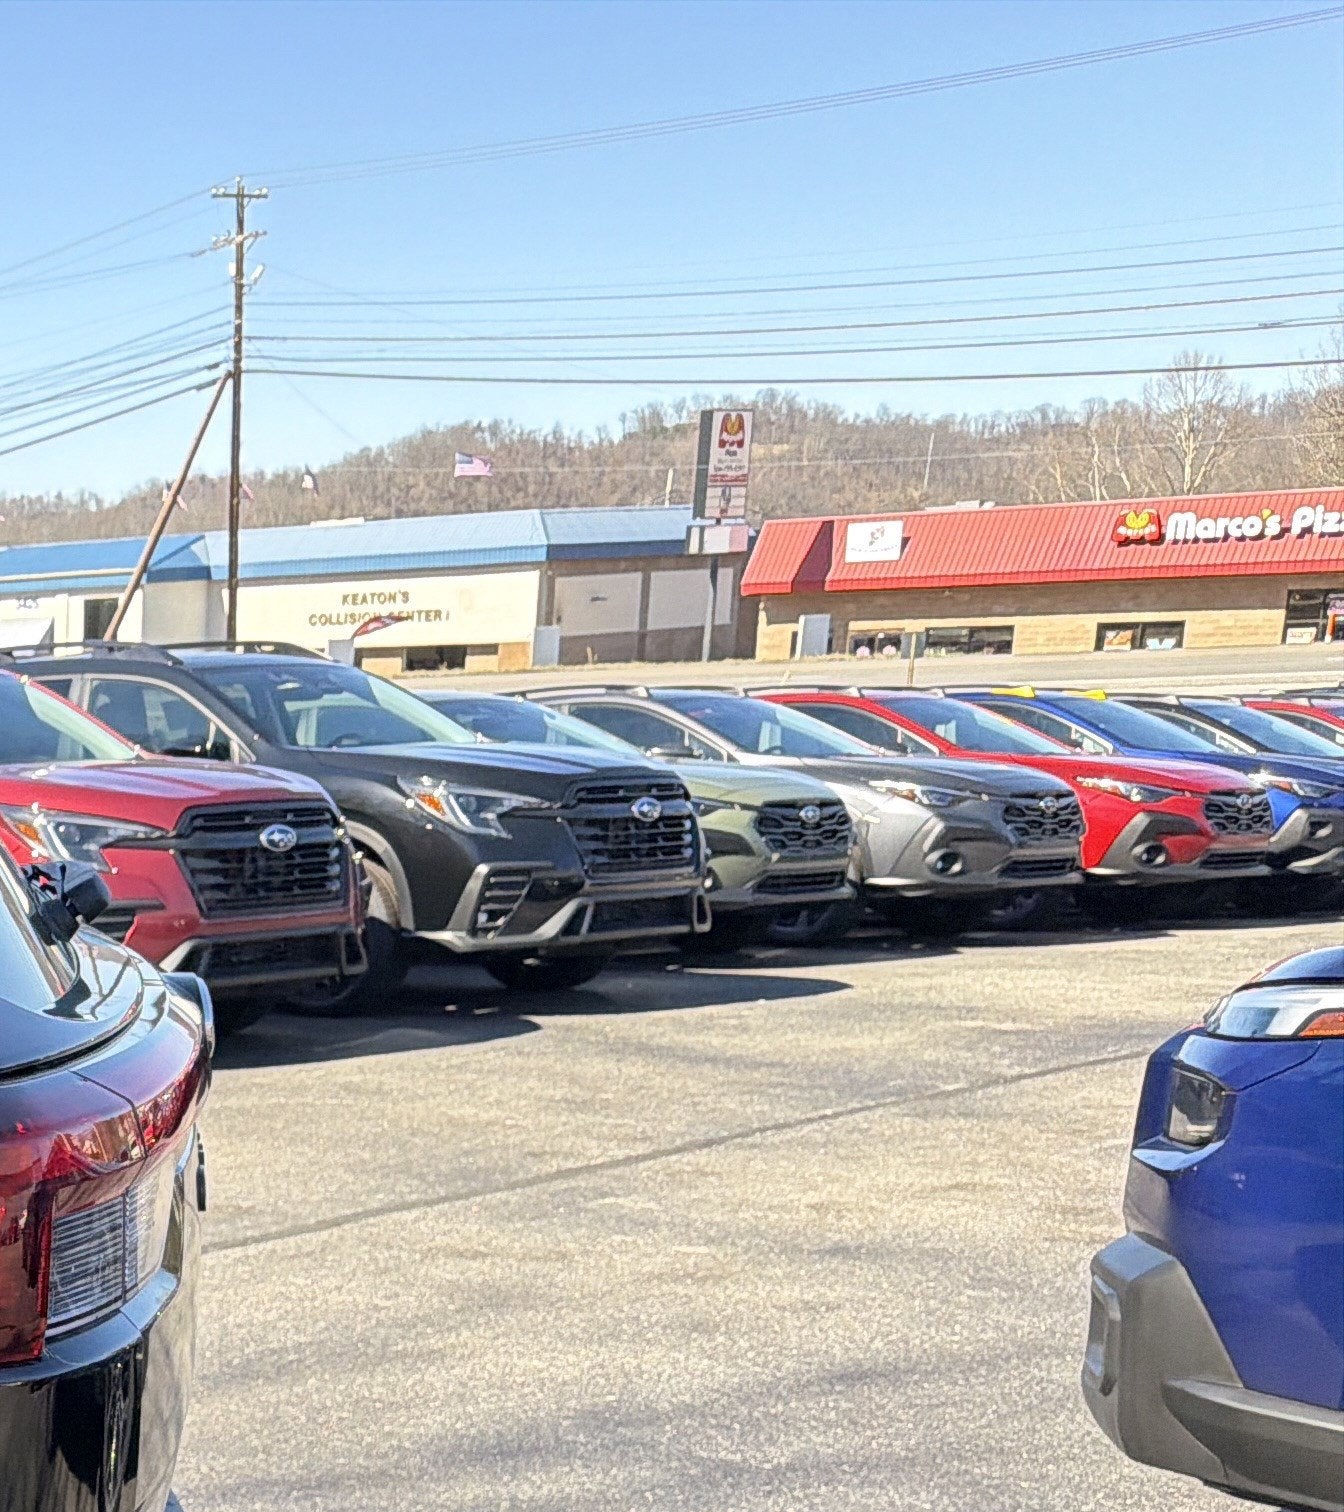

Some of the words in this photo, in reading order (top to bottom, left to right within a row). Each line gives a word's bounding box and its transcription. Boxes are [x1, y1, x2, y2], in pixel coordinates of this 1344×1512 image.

[1166, 508, 1281, 541] Marco's
[1290, 504, 1344, 535] Piz
[341, 590, 410, 606] KEATON'S
